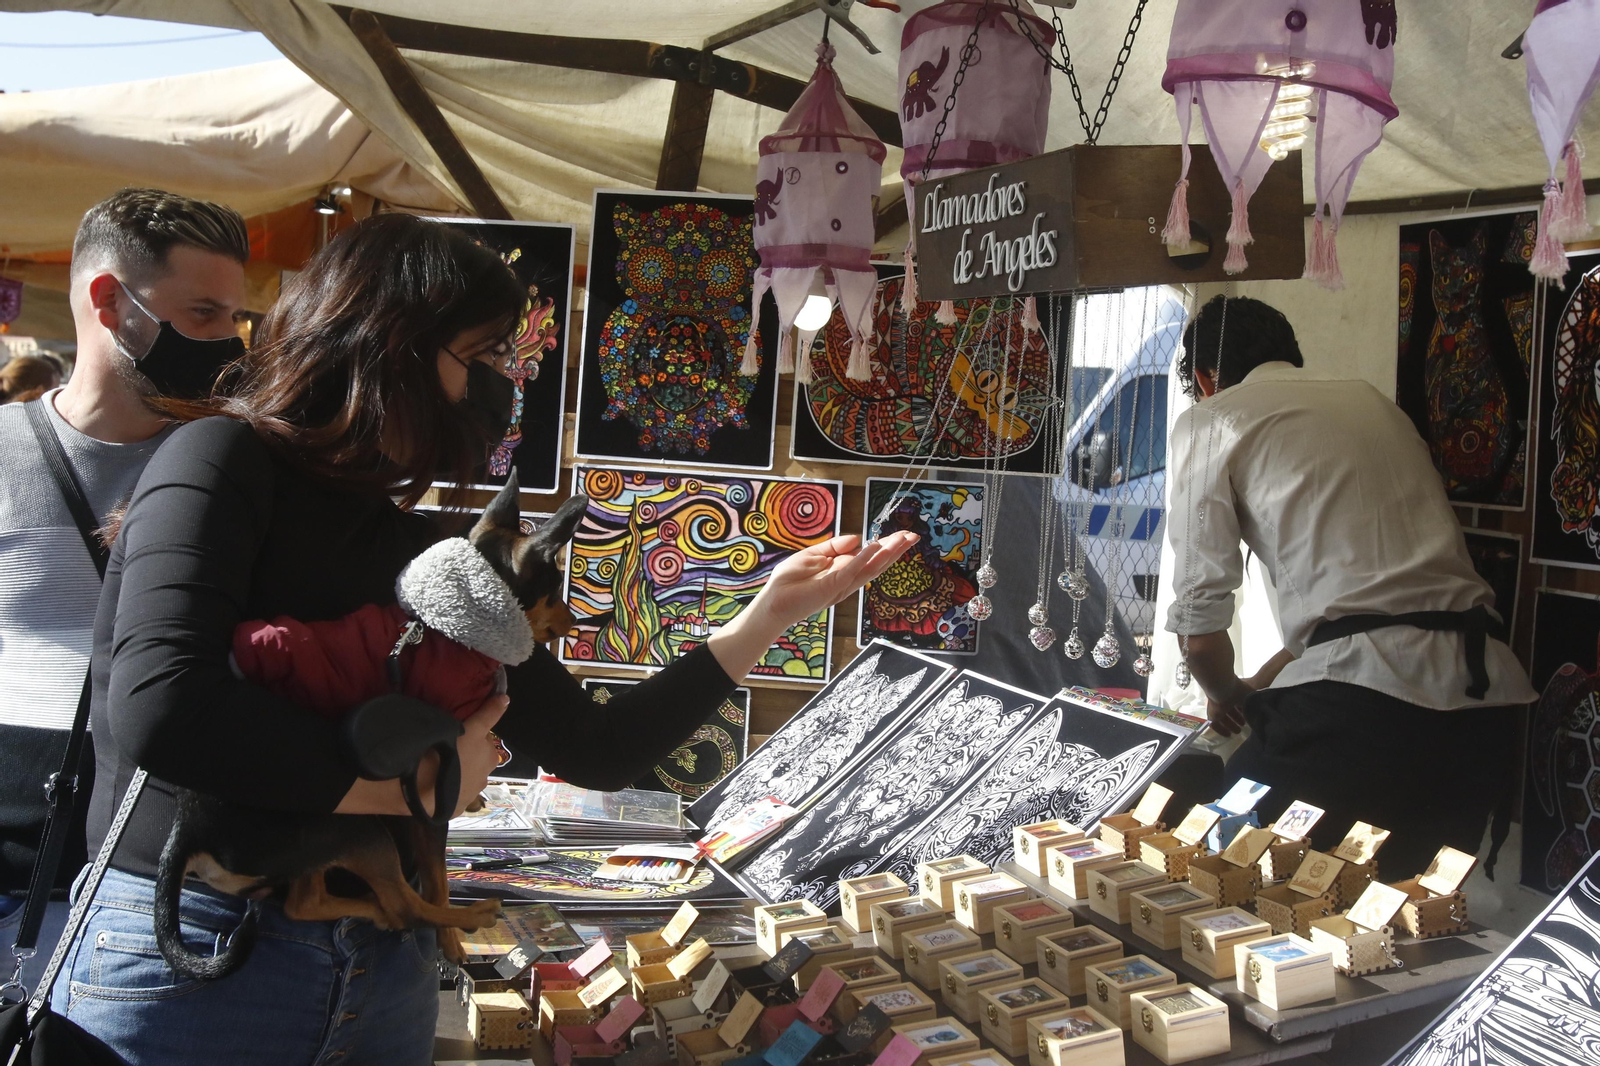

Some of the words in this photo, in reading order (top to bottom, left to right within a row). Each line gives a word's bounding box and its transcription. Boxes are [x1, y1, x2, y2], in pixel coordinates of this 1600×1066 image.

[921, 172, 1027, 233] Llamadores
[953, 227, 974, 285] de
[975, 212, 1058, 292] Angeles
